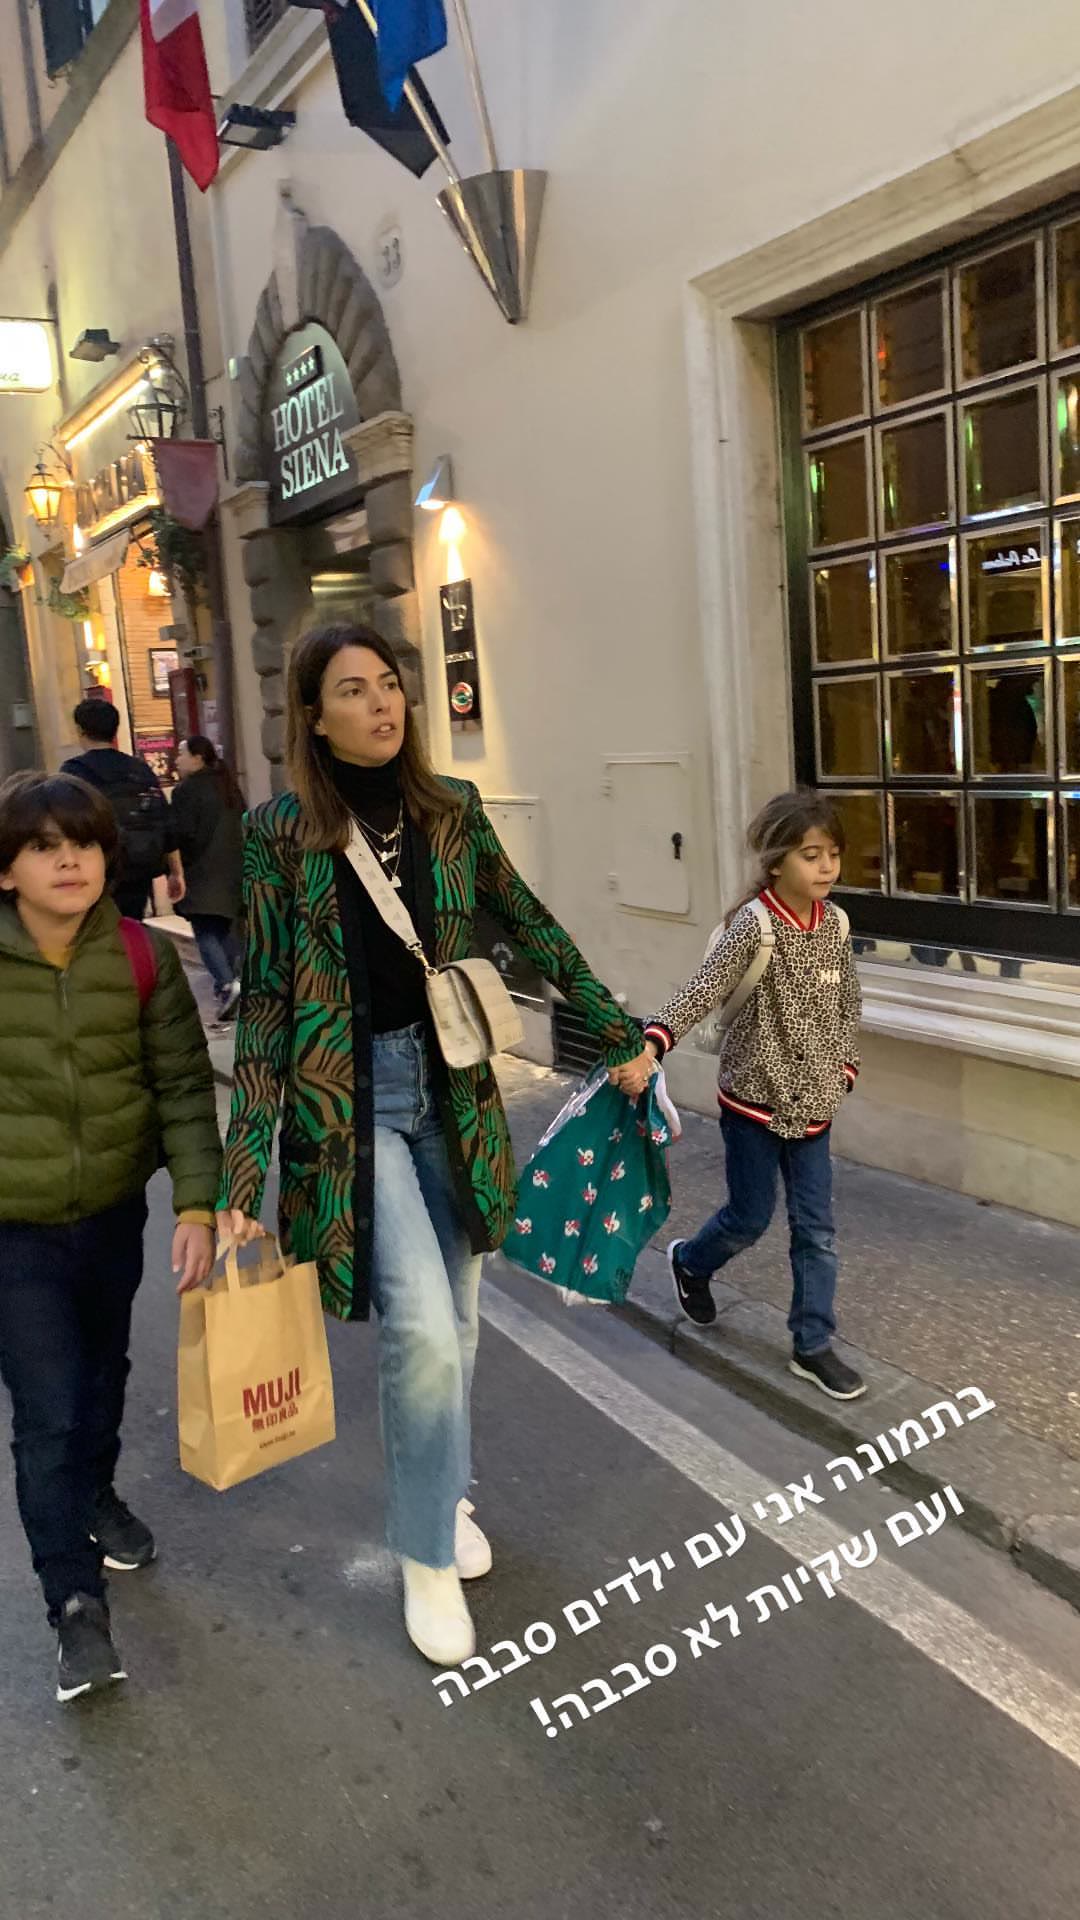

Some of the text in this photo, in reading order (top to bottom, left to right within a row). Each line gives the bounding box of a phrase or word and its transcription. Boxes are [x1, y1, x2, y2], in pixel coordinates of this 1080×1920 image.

[270, 372, 344, 452] HOTEL
[280, 427, 350, 500] SIENA
[242, 1367, 302, 1419] MUJI
